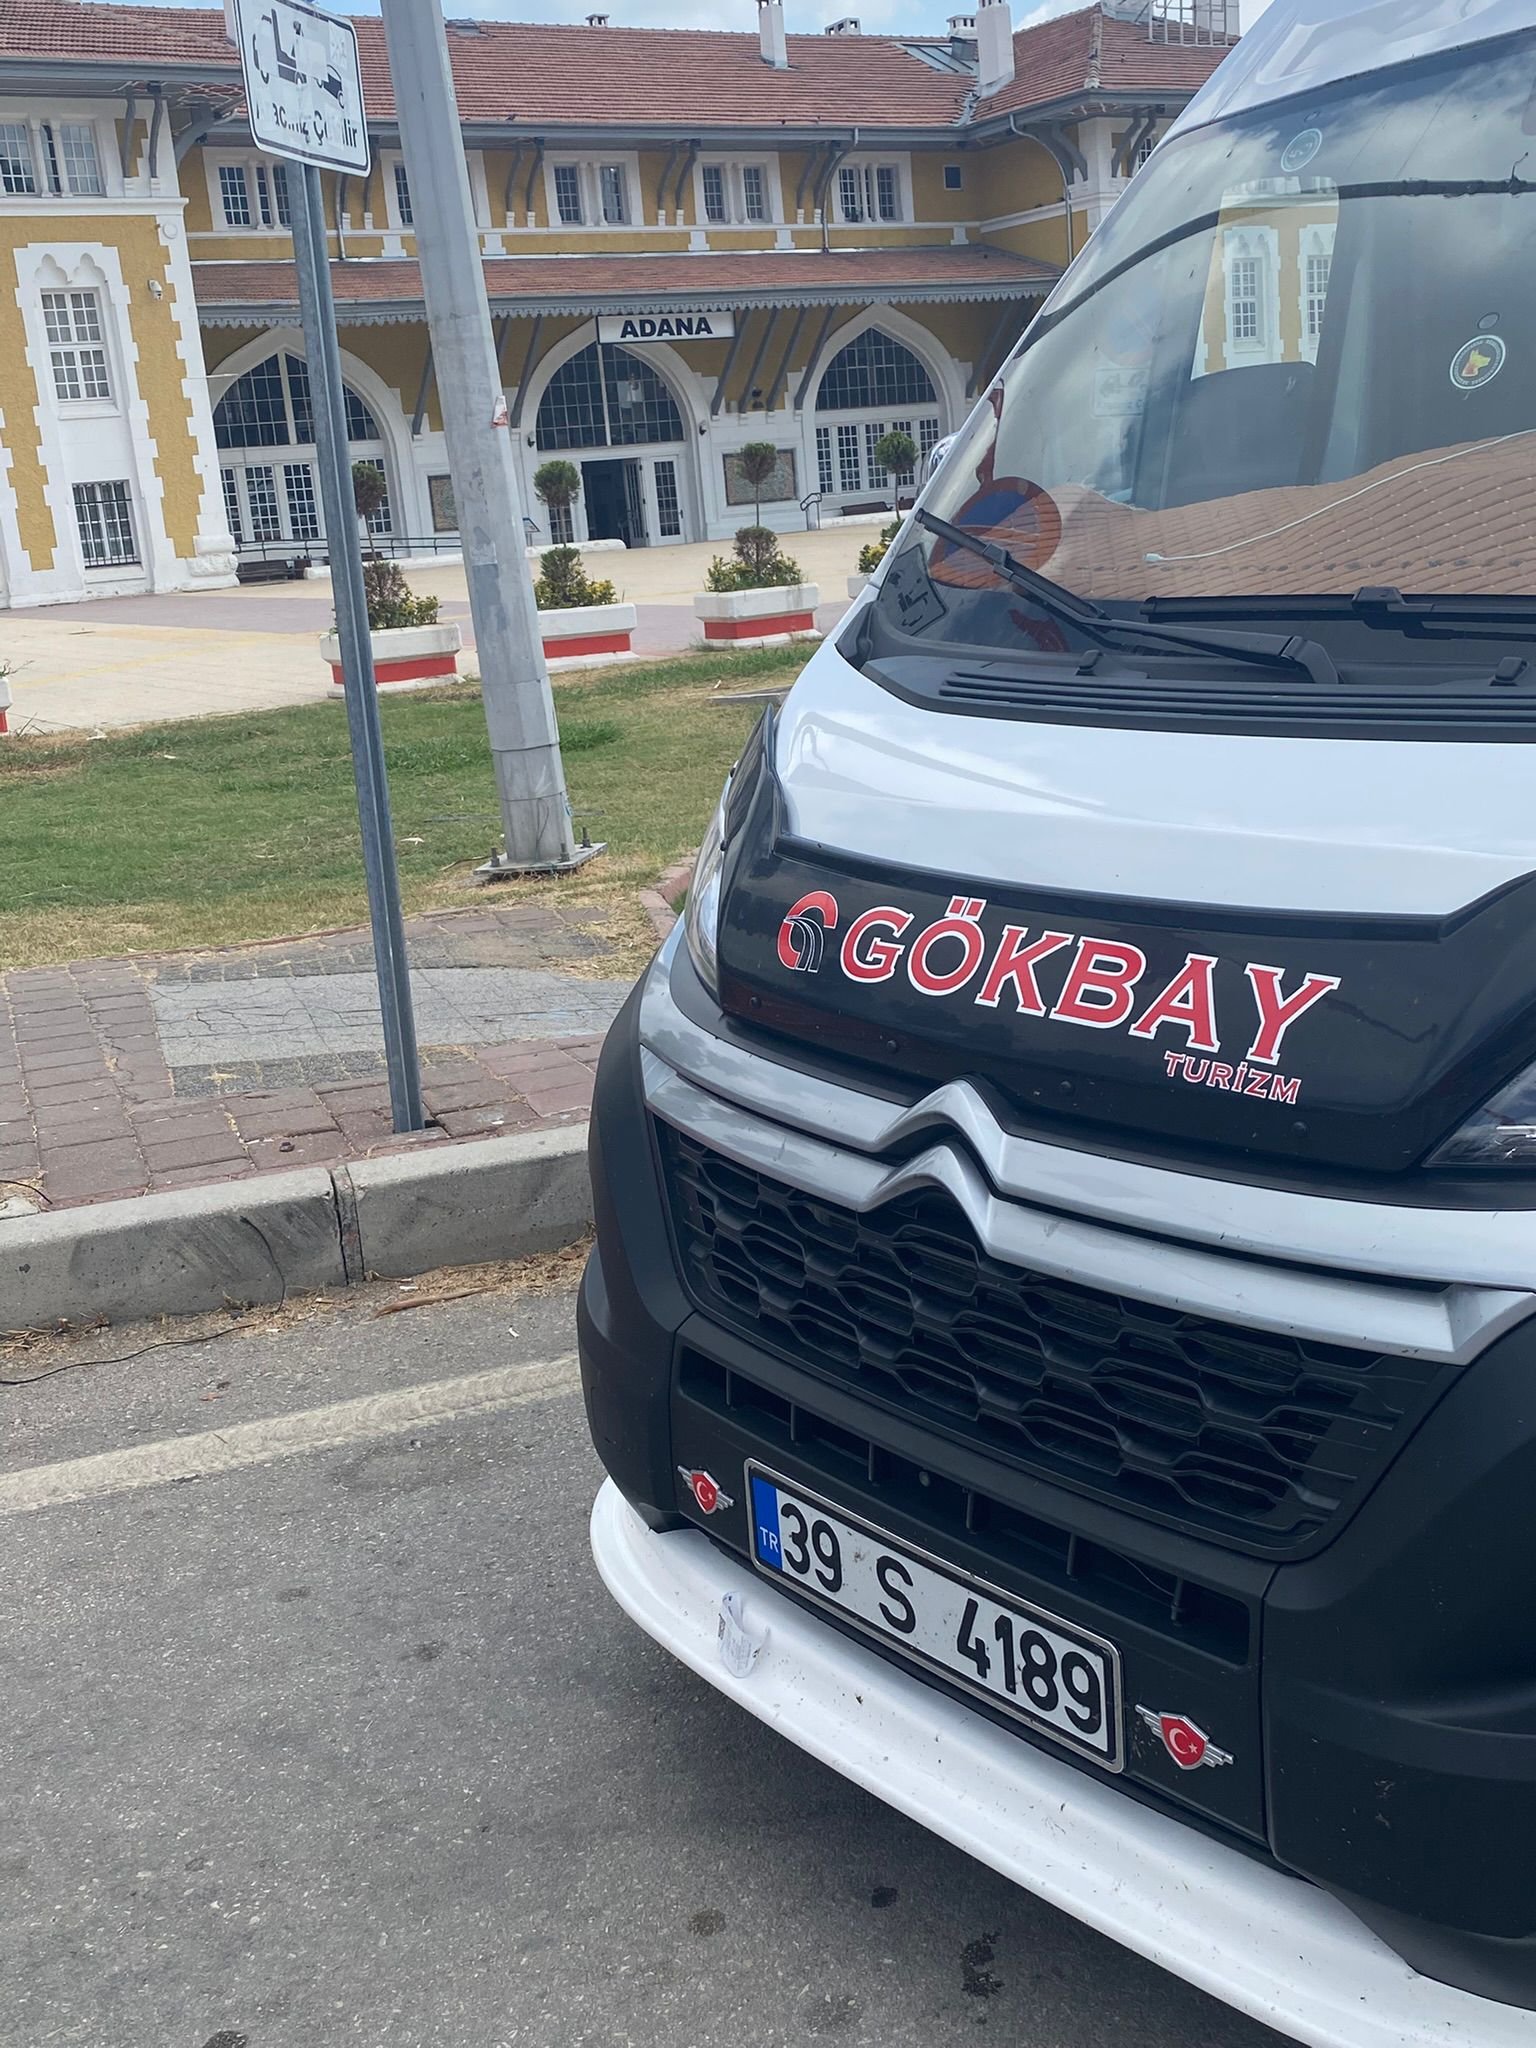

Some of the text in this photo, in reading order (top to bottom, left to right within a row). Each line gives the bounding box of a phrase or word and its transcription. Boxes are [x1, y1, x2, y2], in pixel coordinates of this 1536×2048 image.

[620, 316, 713, 339] ADANA
[840, 895, 1341, 1066] GÖKBAY
[1163, 1051, 1302, 1105] TURİZM
[759, 1525, 780, 1554] TR
[780, 1502, 1103, 1734] 39 S 4189
